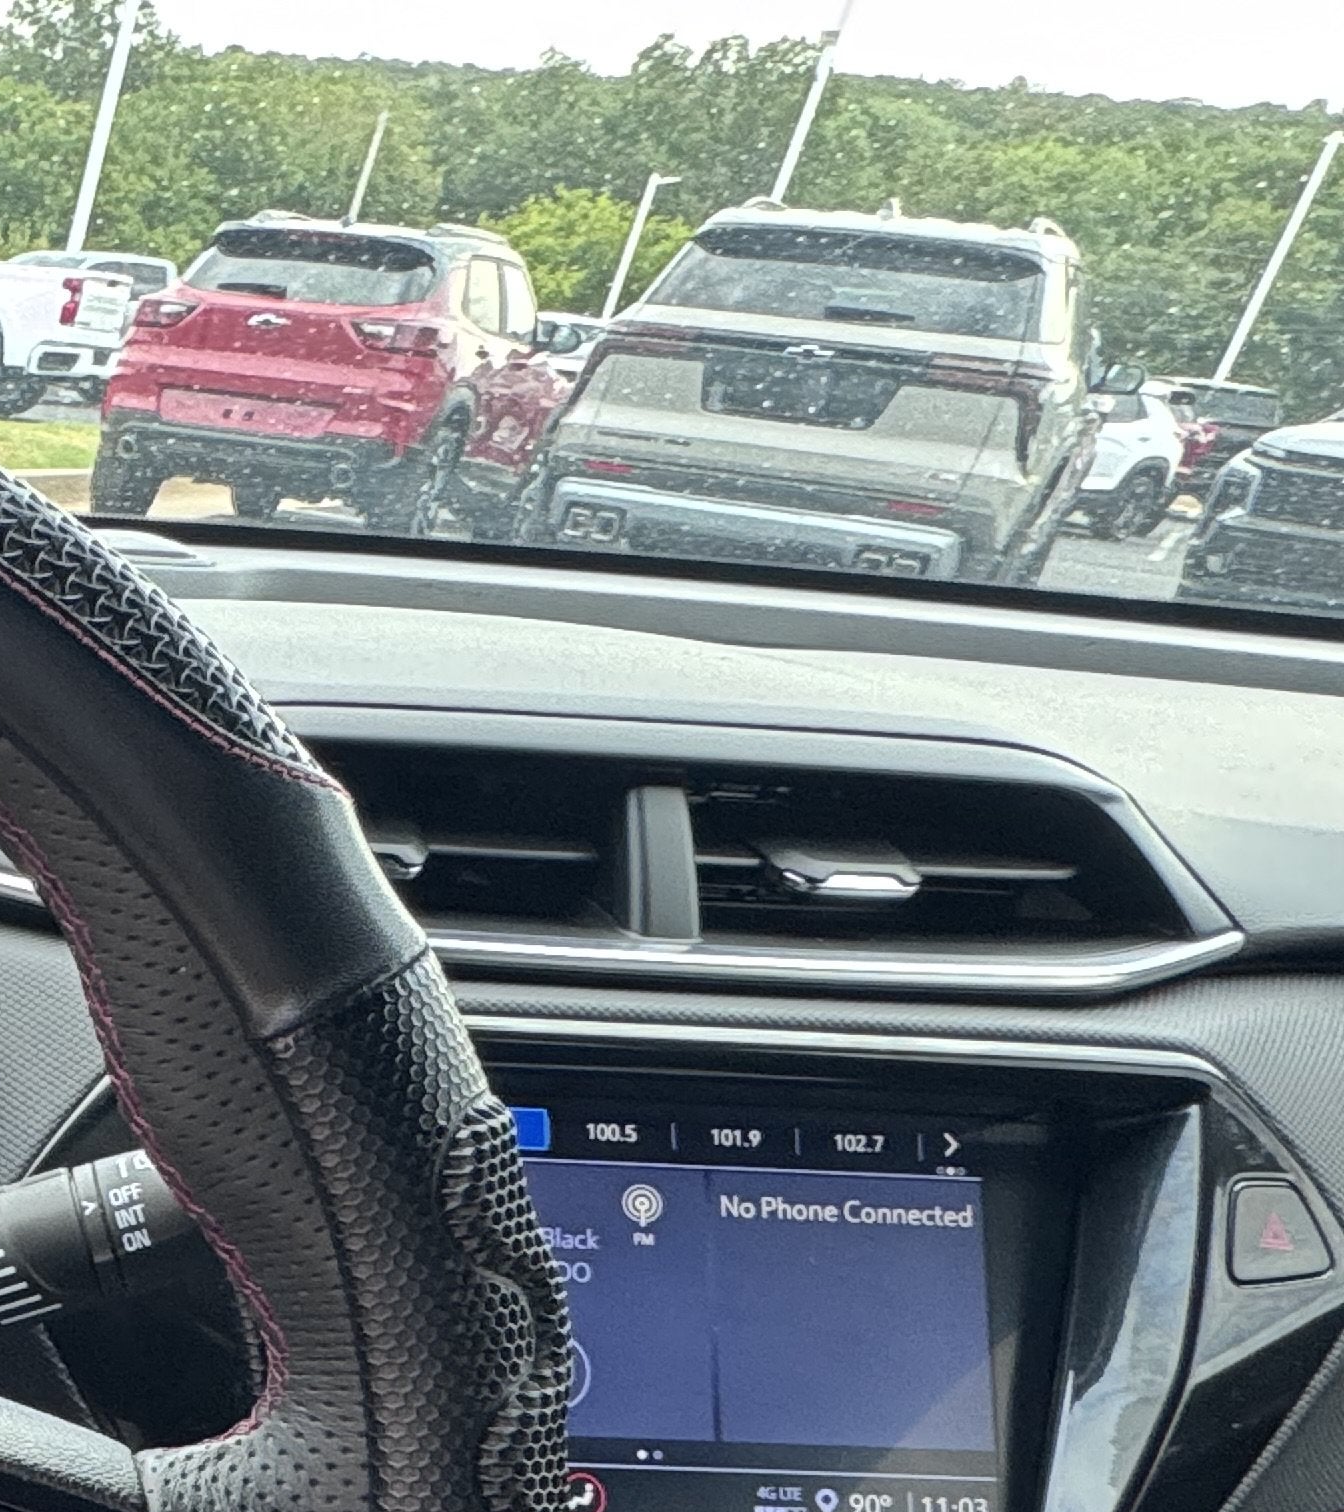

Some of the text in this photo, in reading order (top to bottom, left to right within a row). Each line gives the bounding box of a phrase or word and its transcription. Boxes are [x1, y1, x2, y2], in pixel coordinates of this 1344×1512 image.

[586, 1122, 885, 1154] 100.5 101.9 102.7
[108, 1182, 143, 1207] OFF
[114, 1204, 146, 1230] INT
[719, 1195, 975, 1229] No Phone Connected
[122, 1229, 153, 1252] ON
[632, 1232, 656, 1248] FM
[756, 1486, 804, 1502] 4G LTE
